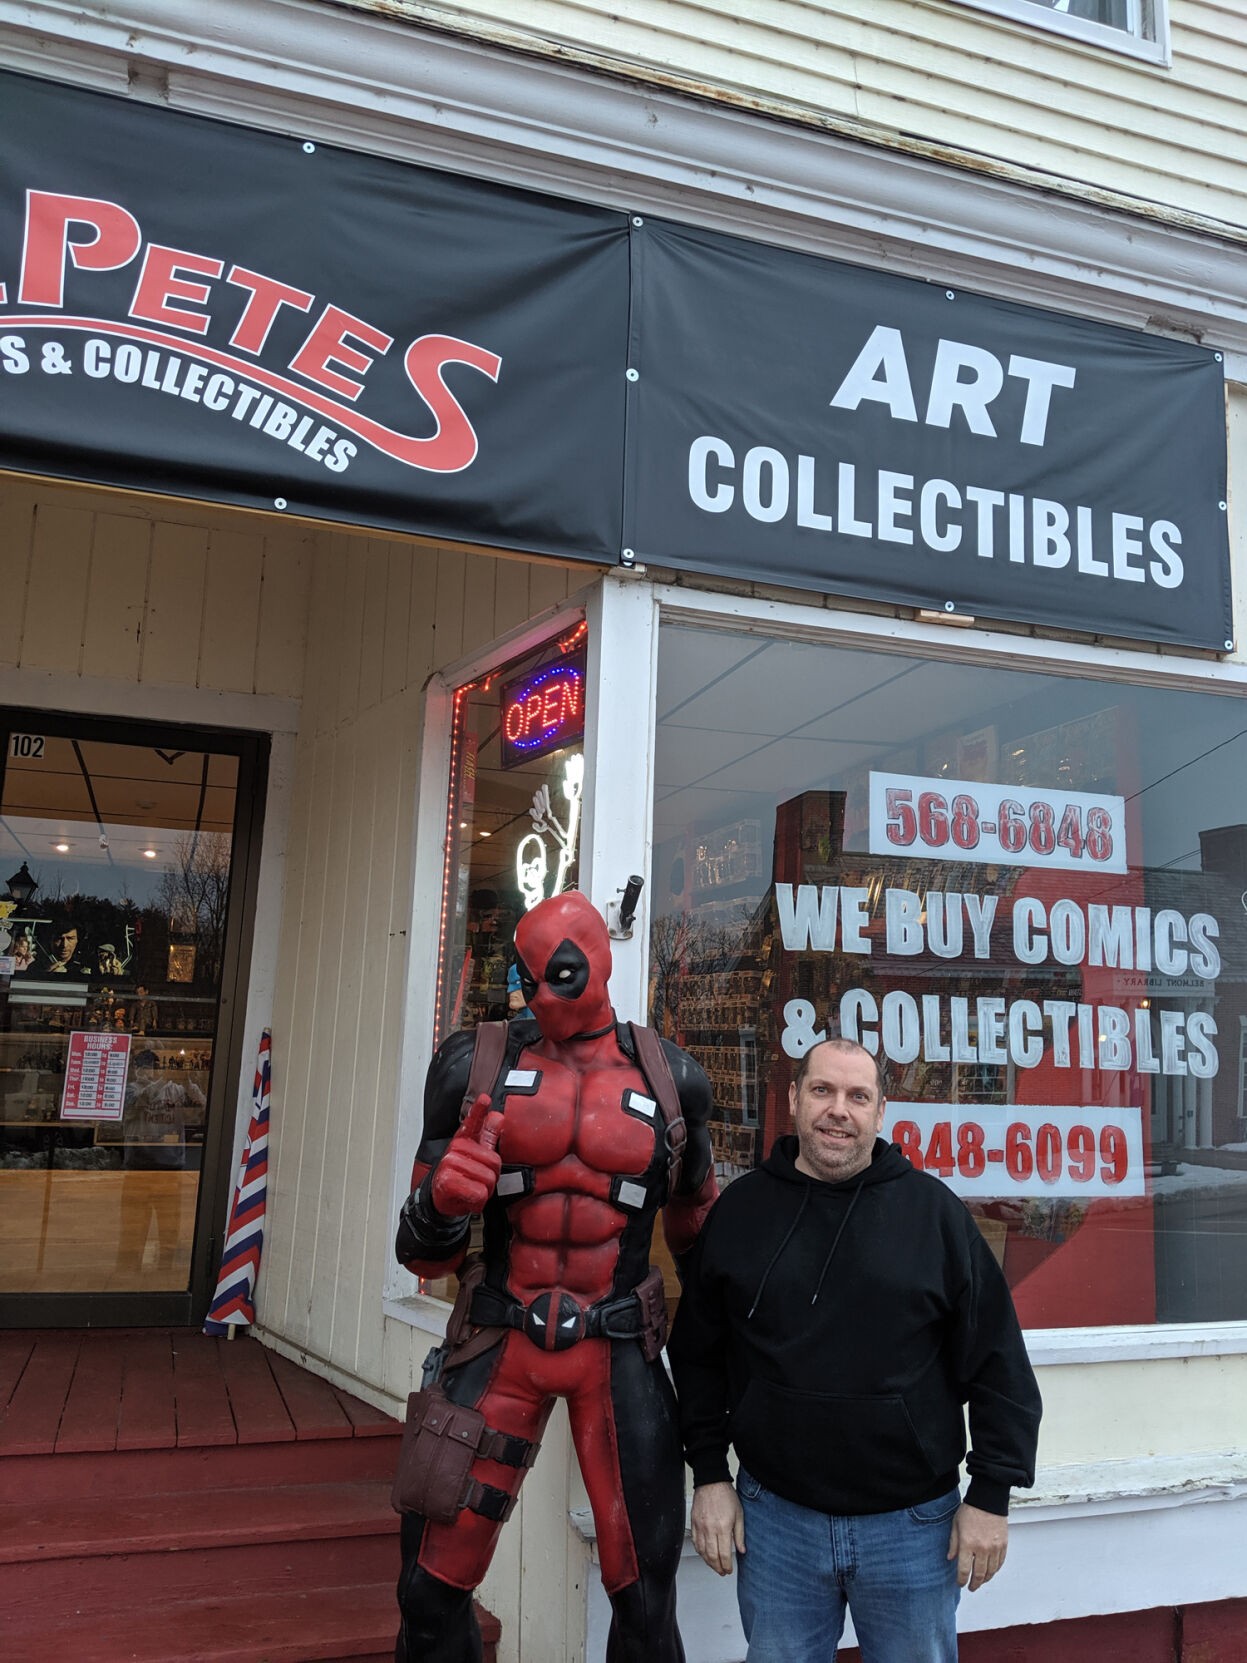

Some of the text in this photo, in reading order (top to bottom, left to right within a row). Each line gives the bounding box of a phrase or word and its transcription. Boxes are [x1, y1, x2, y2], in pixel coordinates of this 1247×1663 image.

[41, 341, 72, 374] &
[83, 339, 358, 473] COLLECTIBLES
[829, 325, 1077, 447] ART
[688, 436, 1184, 588] COLLECTIBLES
[13, 736, 44, 757] 102
[506, 675, 580, 740] OPEN
[885, 787, 1114, 862] 568-6848
[775, 882, 1220, 979] WE BUY COMICS
[781, 988, 1219, 1078] & COLLECTIBLES
[891, 1120, 1128, 1185] 848-6099
